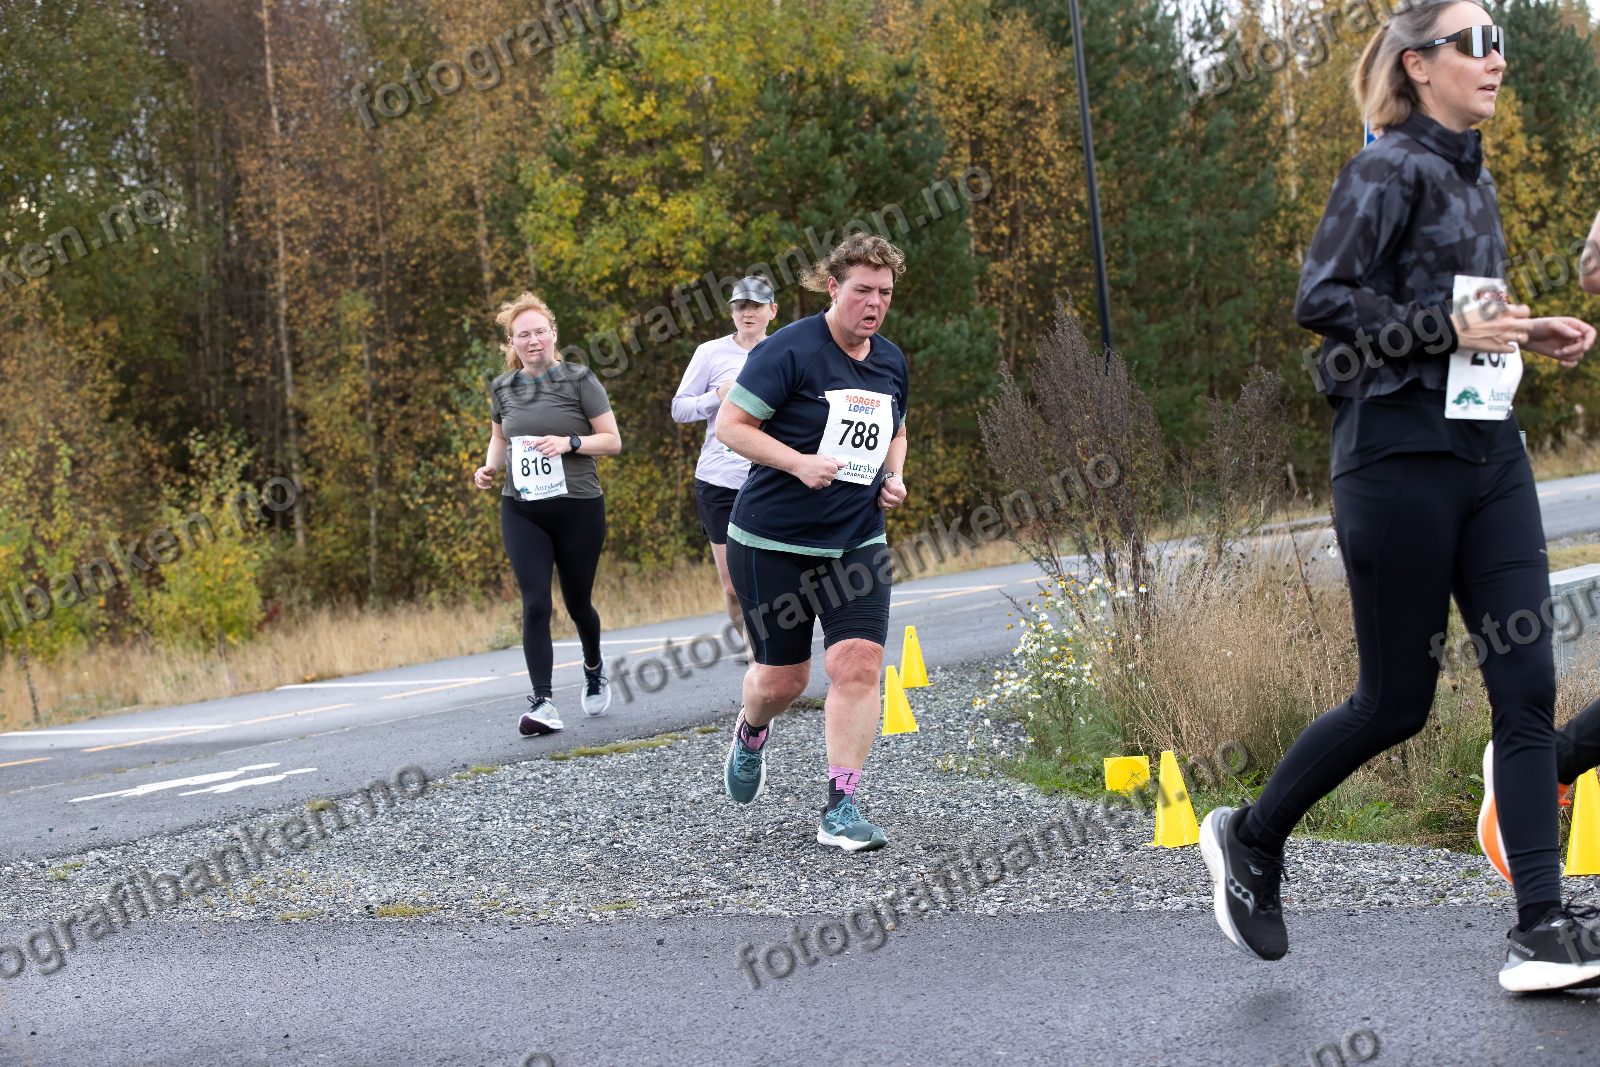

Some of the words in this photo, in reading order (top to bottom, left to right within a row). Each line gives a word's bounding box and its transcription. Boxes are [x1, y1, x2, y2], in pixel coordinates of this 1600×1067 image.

[846, 395, 880, 408] NORGES
[848, 404, 875, 415] LØPET
[839, 419, 880, 451] 788
[522, 457, 551, 477] 816
